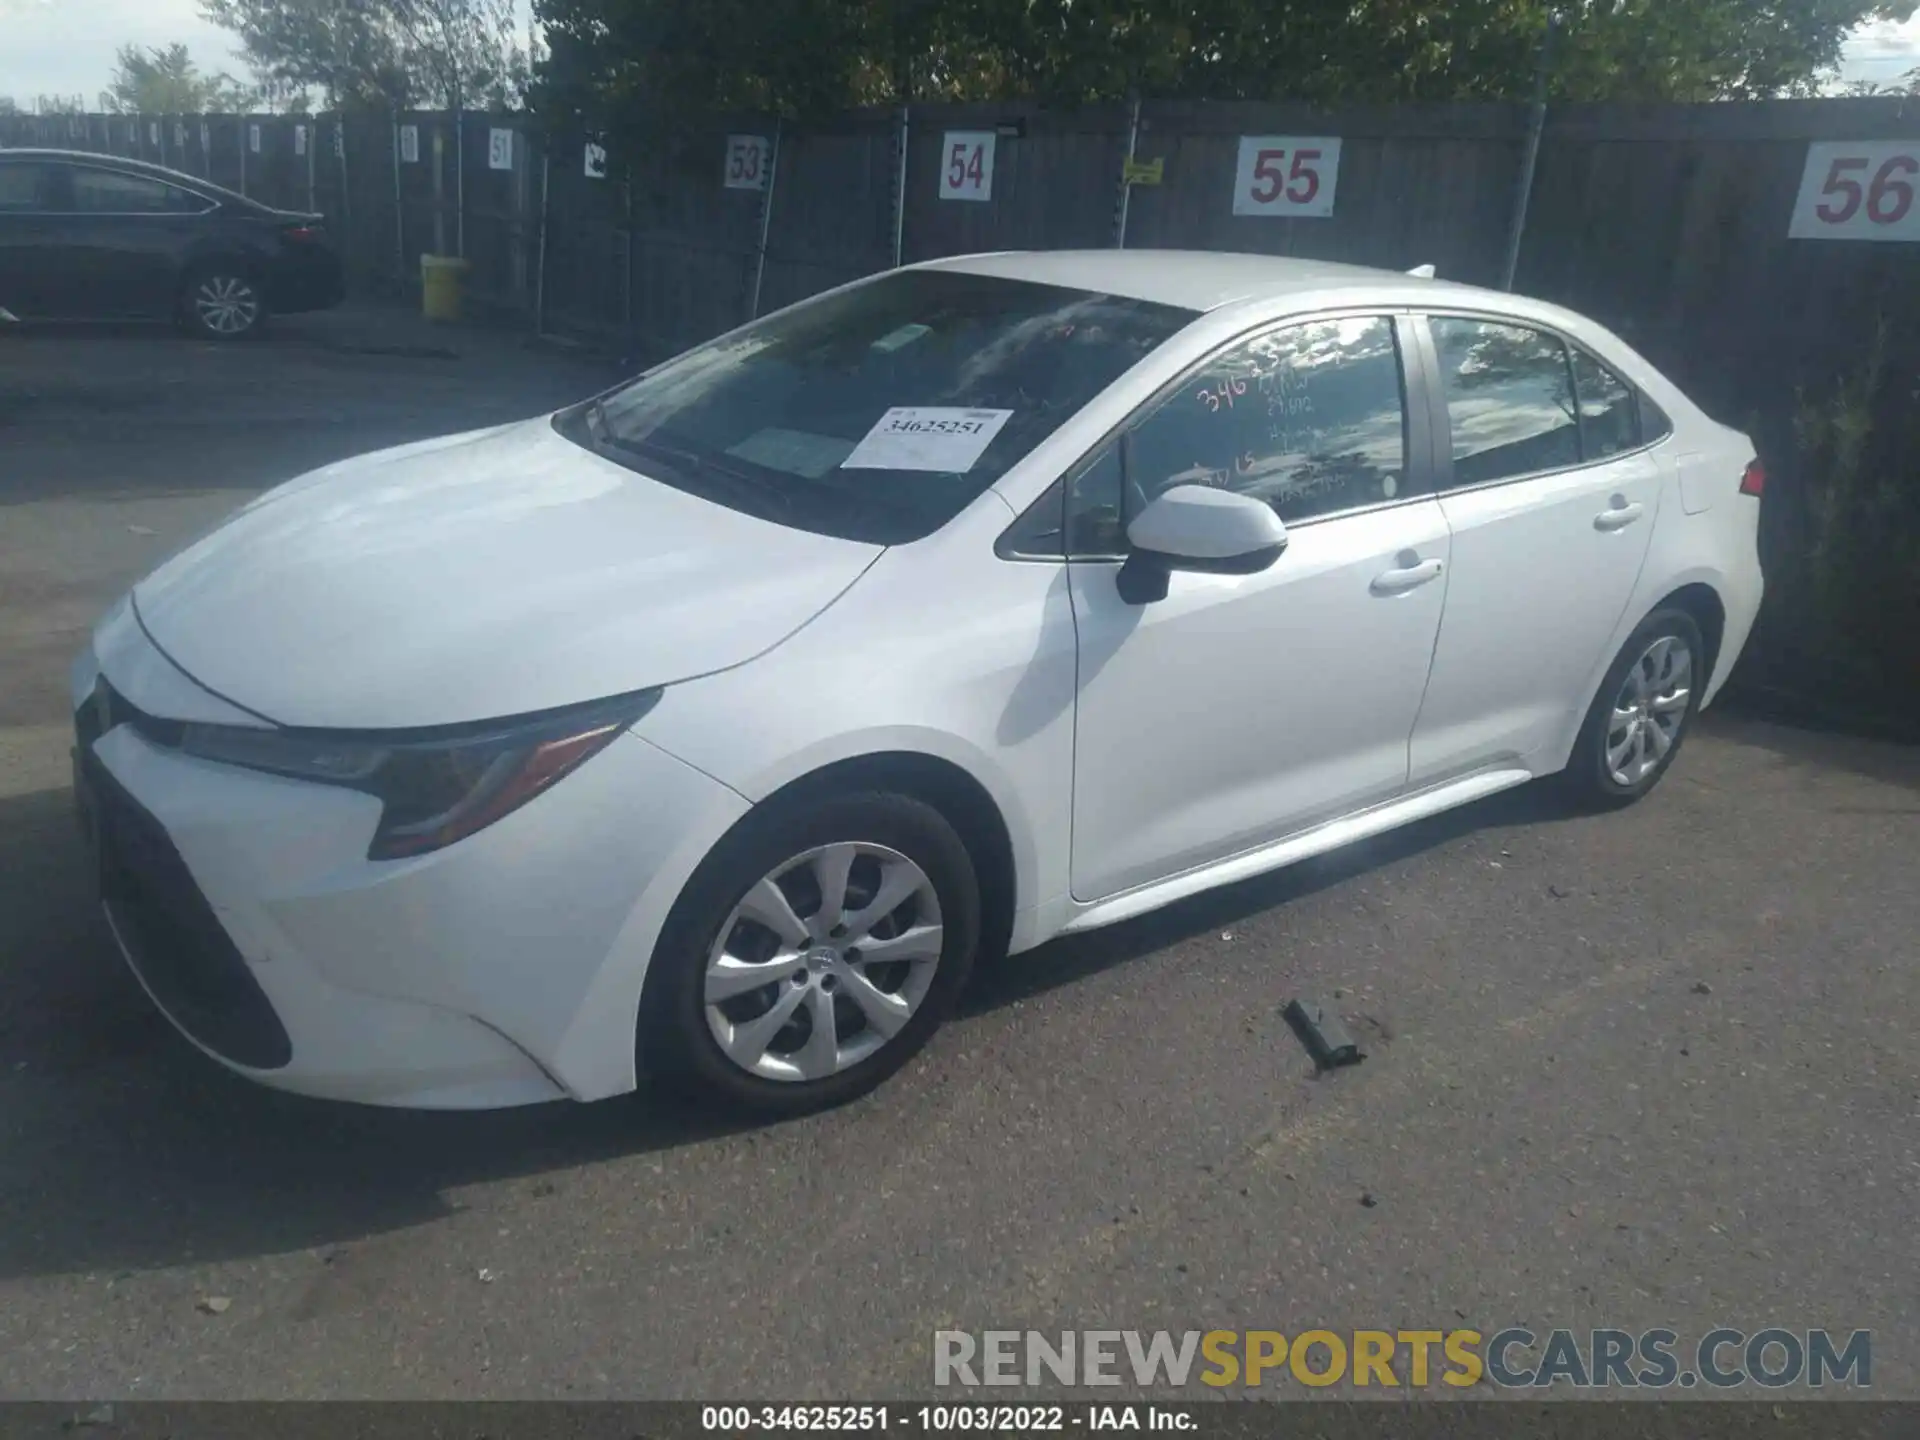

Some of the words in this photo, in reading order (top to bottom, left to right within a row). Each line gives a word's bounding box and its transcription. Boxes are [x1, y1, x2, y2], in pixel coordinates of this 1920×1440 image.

[730, 144, 759, 181] 53
[948, 143, 984, 190] 54
[1250, 149, 1322, 204] 55
[1815, 155, 1919, 225] 56
[884, 419, 986, 435] 34625251
